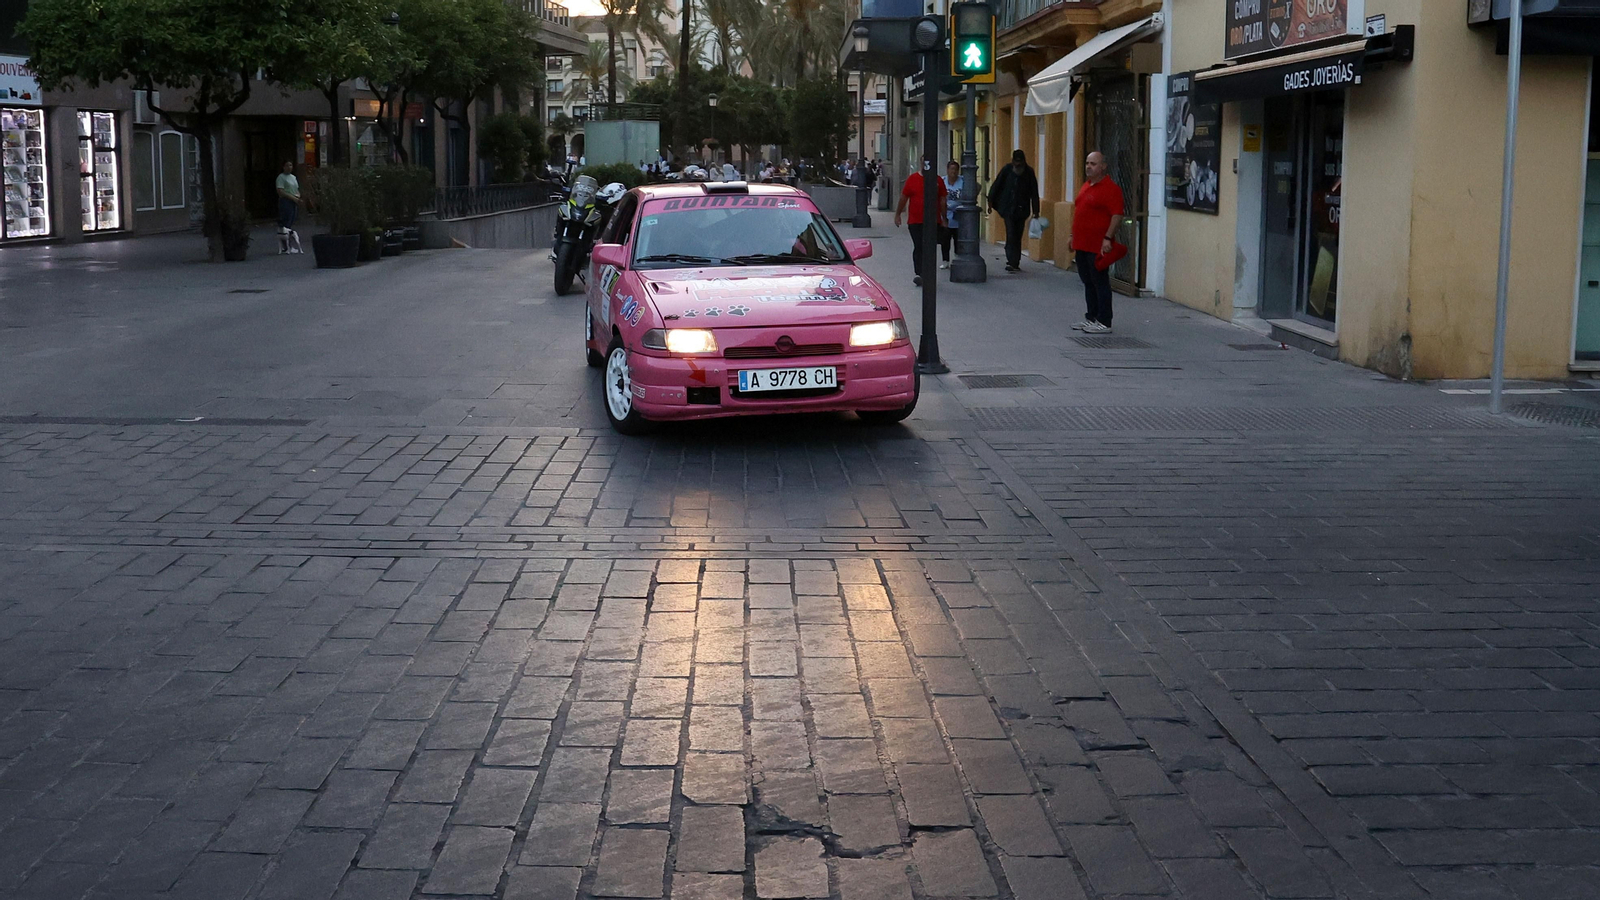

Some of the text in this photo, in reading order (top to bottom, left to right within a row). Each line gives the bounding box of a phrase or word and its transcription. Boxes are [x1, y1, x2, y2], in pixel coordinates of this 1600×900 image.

[1284, 59, 1354, 91] GADES JOYERÍAS
[751, 368, 833, 388] A 9778 CH
